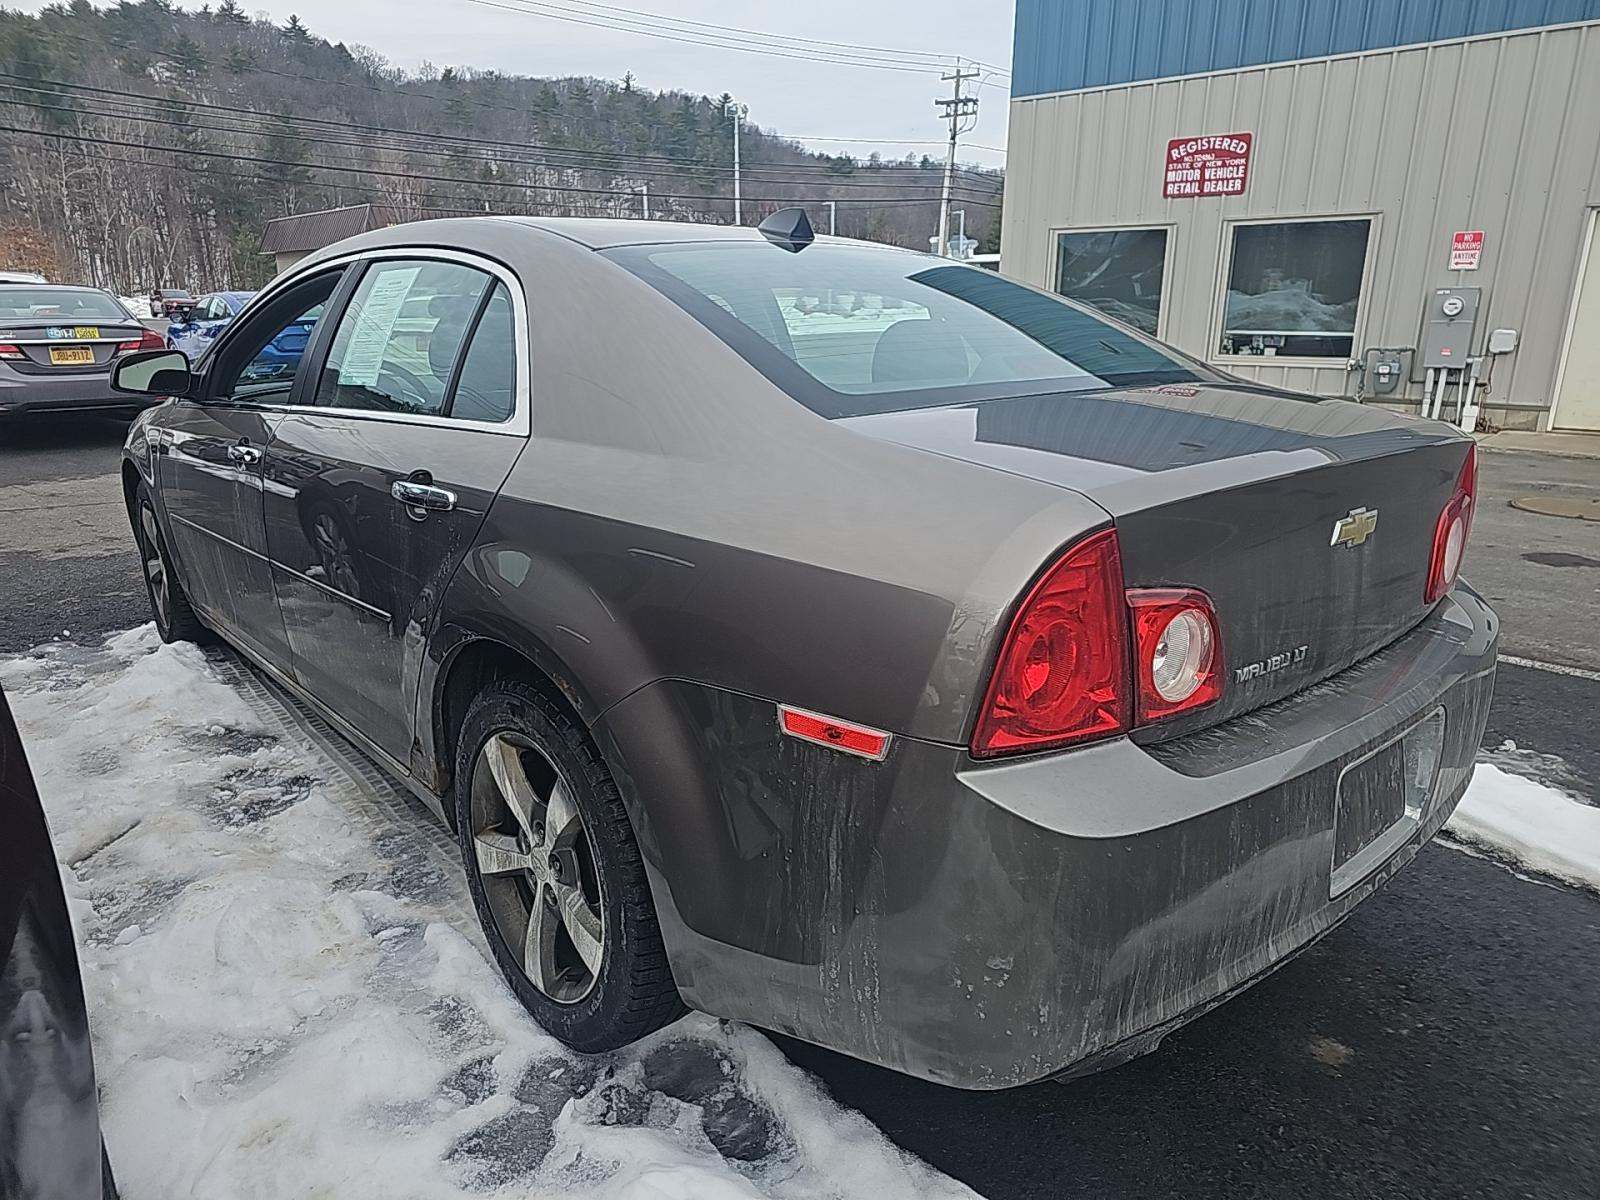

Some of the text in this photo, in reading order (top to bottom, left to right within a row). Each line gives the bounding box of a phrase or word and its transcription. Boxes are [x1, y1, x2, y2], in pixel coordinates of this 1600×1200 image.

[1171, 137, 1247, 160] REGISTERED
[1225, 158, 1247, 166] YORK
[1167, 166, 1245, 182] MOTOR VEHICLE
[1167, 180, 1242, 195] RETAIL DEALER
[1453, 241, 1481, 250] PARKING
[1454, 252, 1478, 260] ANYTIME
[1234, 645, 1309, 684] MALIBU LT
